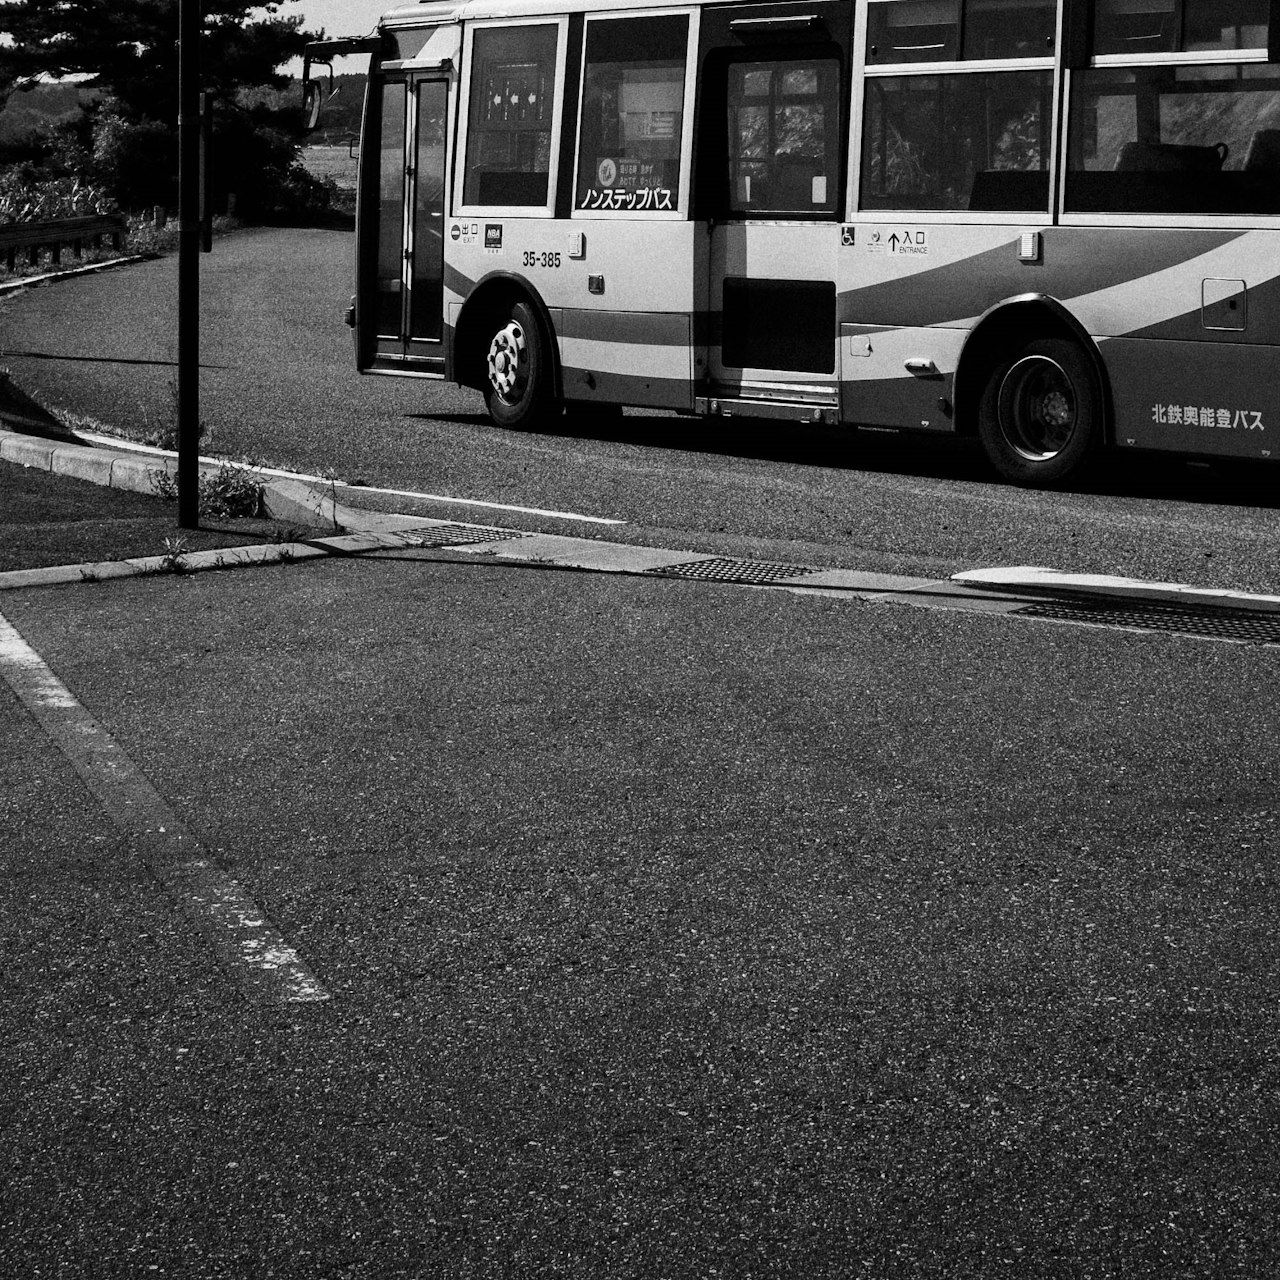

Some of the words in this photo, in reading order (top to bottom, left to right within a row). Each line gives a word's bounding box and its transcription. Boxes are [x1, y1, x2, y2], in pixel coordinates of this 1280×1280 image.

[581, 187, 672, 209] ノンステップバス
[462, 223, 478, 234] 出口
[463, 236, 476, 244] EXIT
[903, 231, 925, 245] 入口
[899, 246, 928, 254] ENTRANCE
[523, 251, 561, 268] 35-385
[1152, 403, 1265, 431] 北鉄奥能登バス
